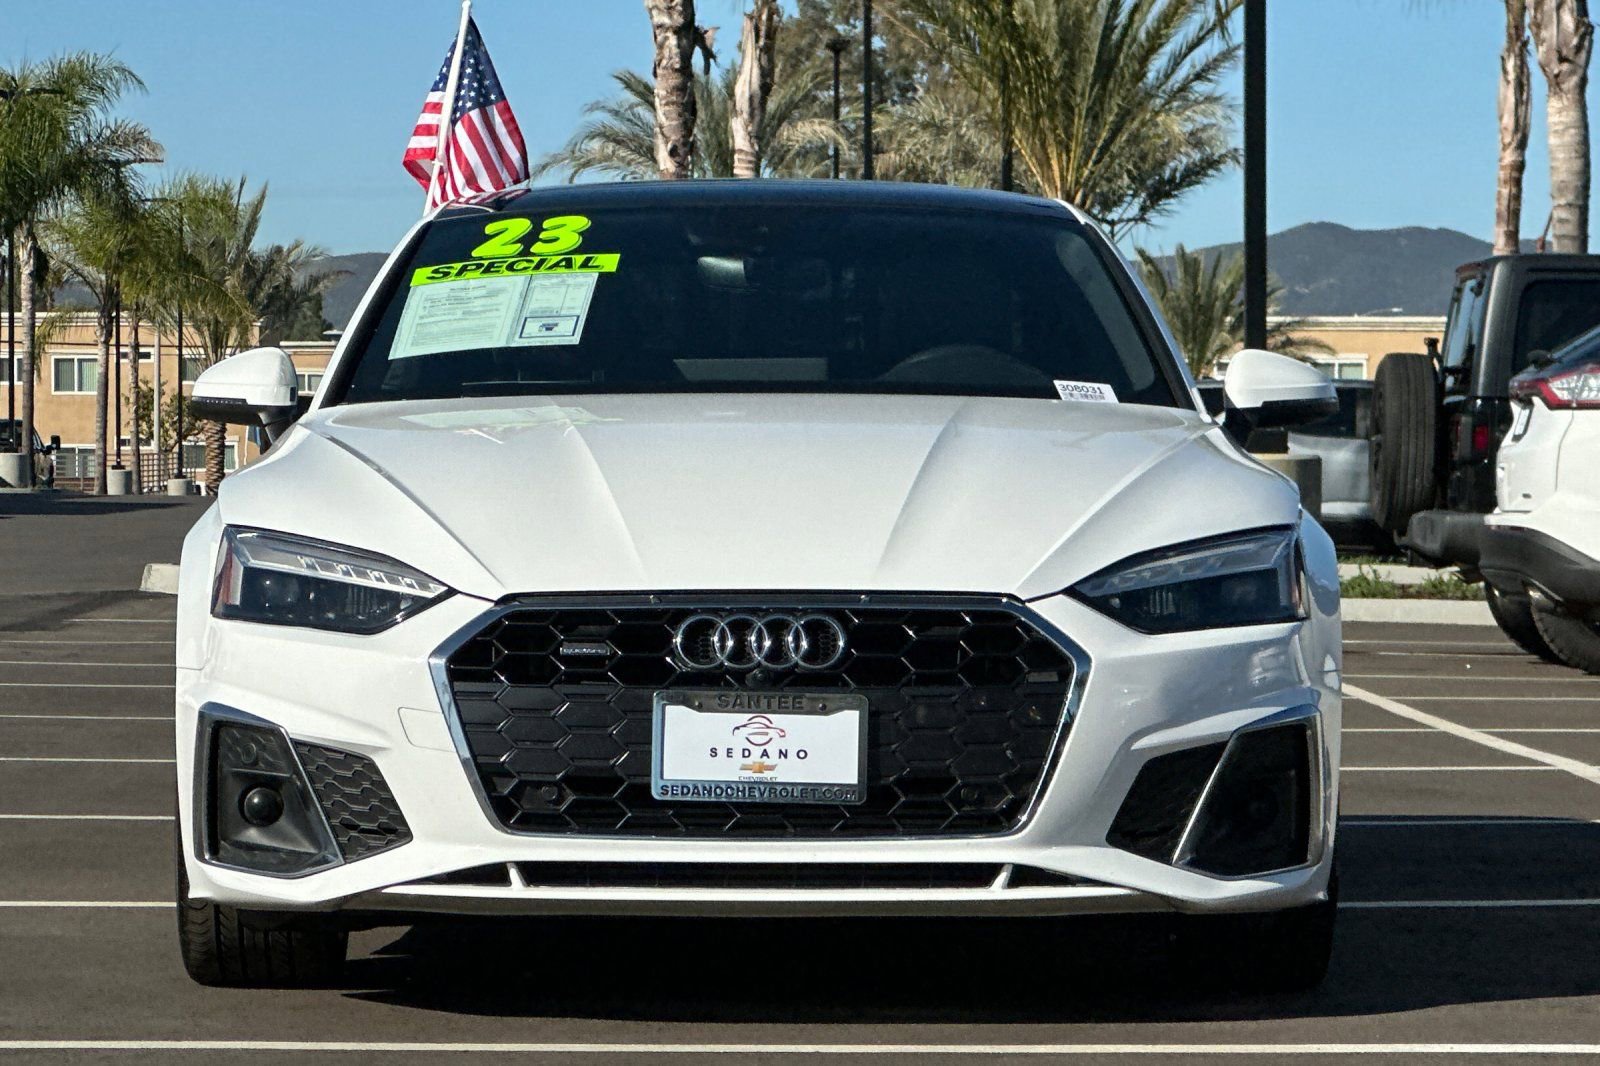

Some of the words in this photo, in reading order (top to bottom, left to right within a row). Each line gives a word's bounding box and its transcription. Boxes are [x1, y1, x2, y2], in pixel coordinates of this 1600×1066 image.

[471, 215, 592, 258] 23
[426, 256, 603, 280] SPECIAL
[1058, 384, 1104, 395] 308031
[717, 694, 805, 711] SANTEE
[709, 747, 808, 760] SEDANO
[660, 783, 857, 800] SEDANOCHEVROLET.COM
